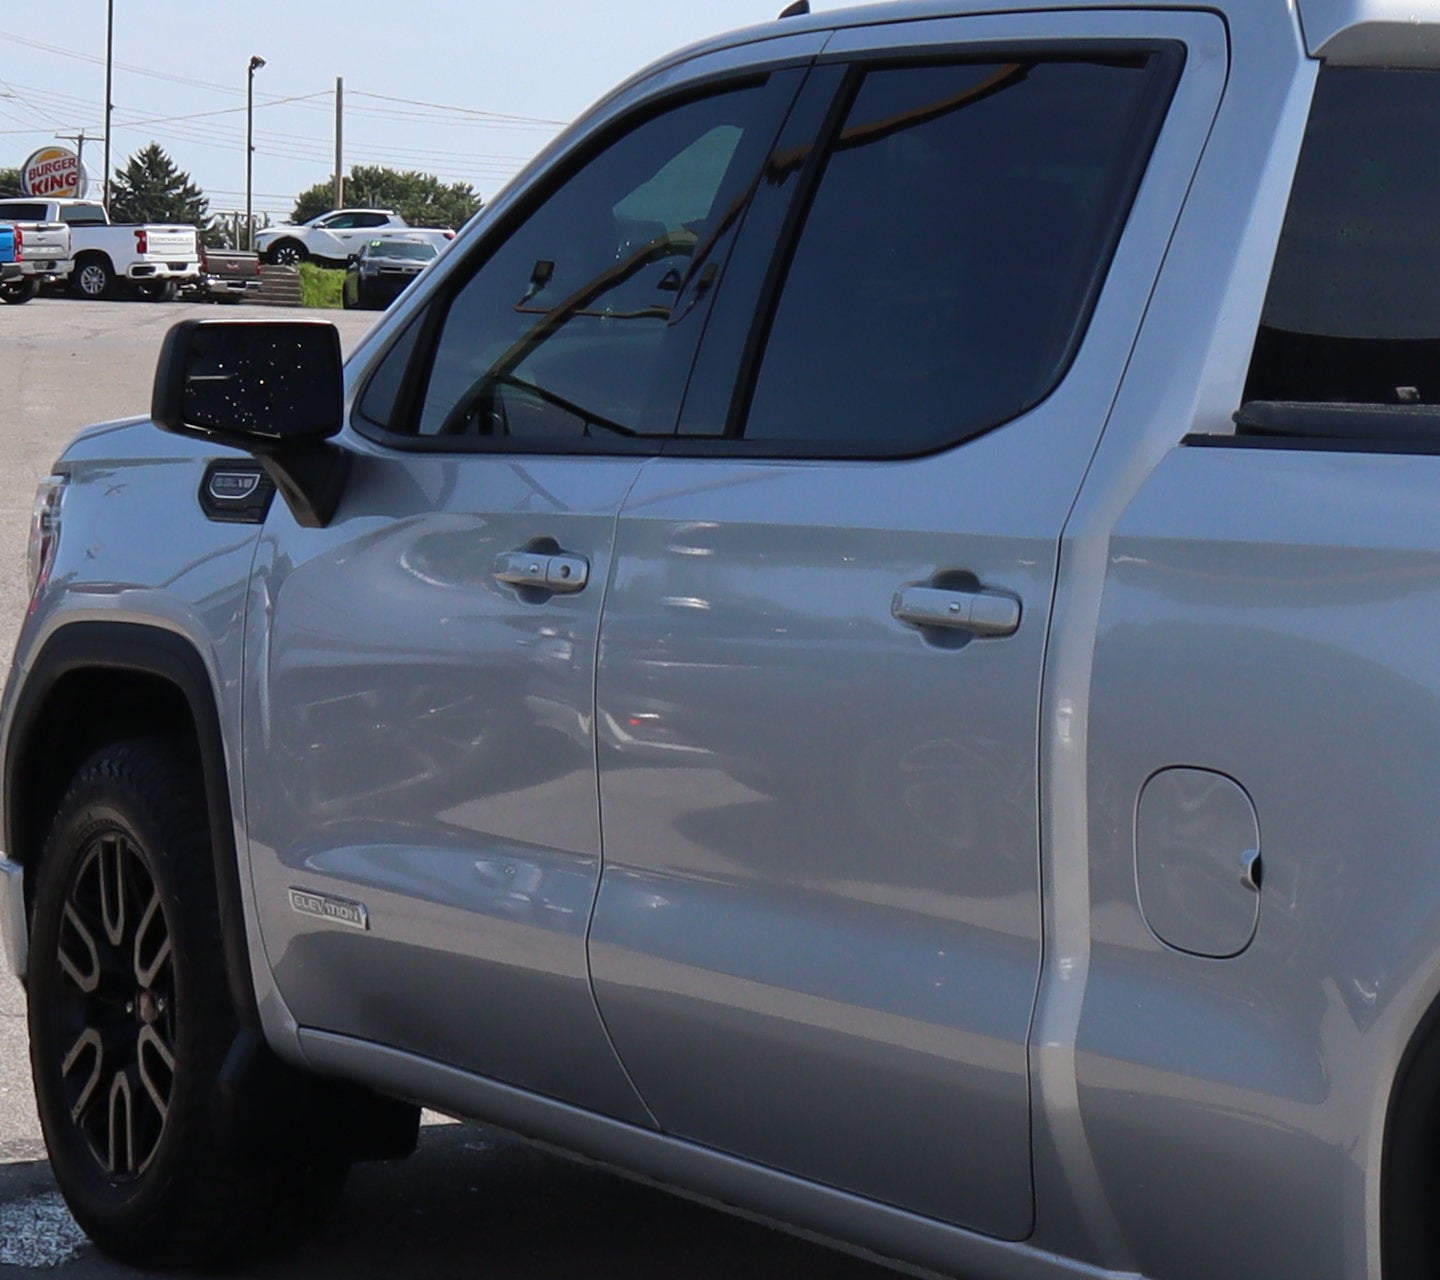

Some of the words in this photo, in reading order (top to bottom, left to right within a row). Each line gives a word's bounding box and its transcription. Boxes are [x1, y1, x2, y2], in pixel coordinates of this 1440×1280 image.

[28, 157, 77, 181] BURGER
[31, 171, 78, 196] KING
[293, 894, 359, 921] ELEVATION
